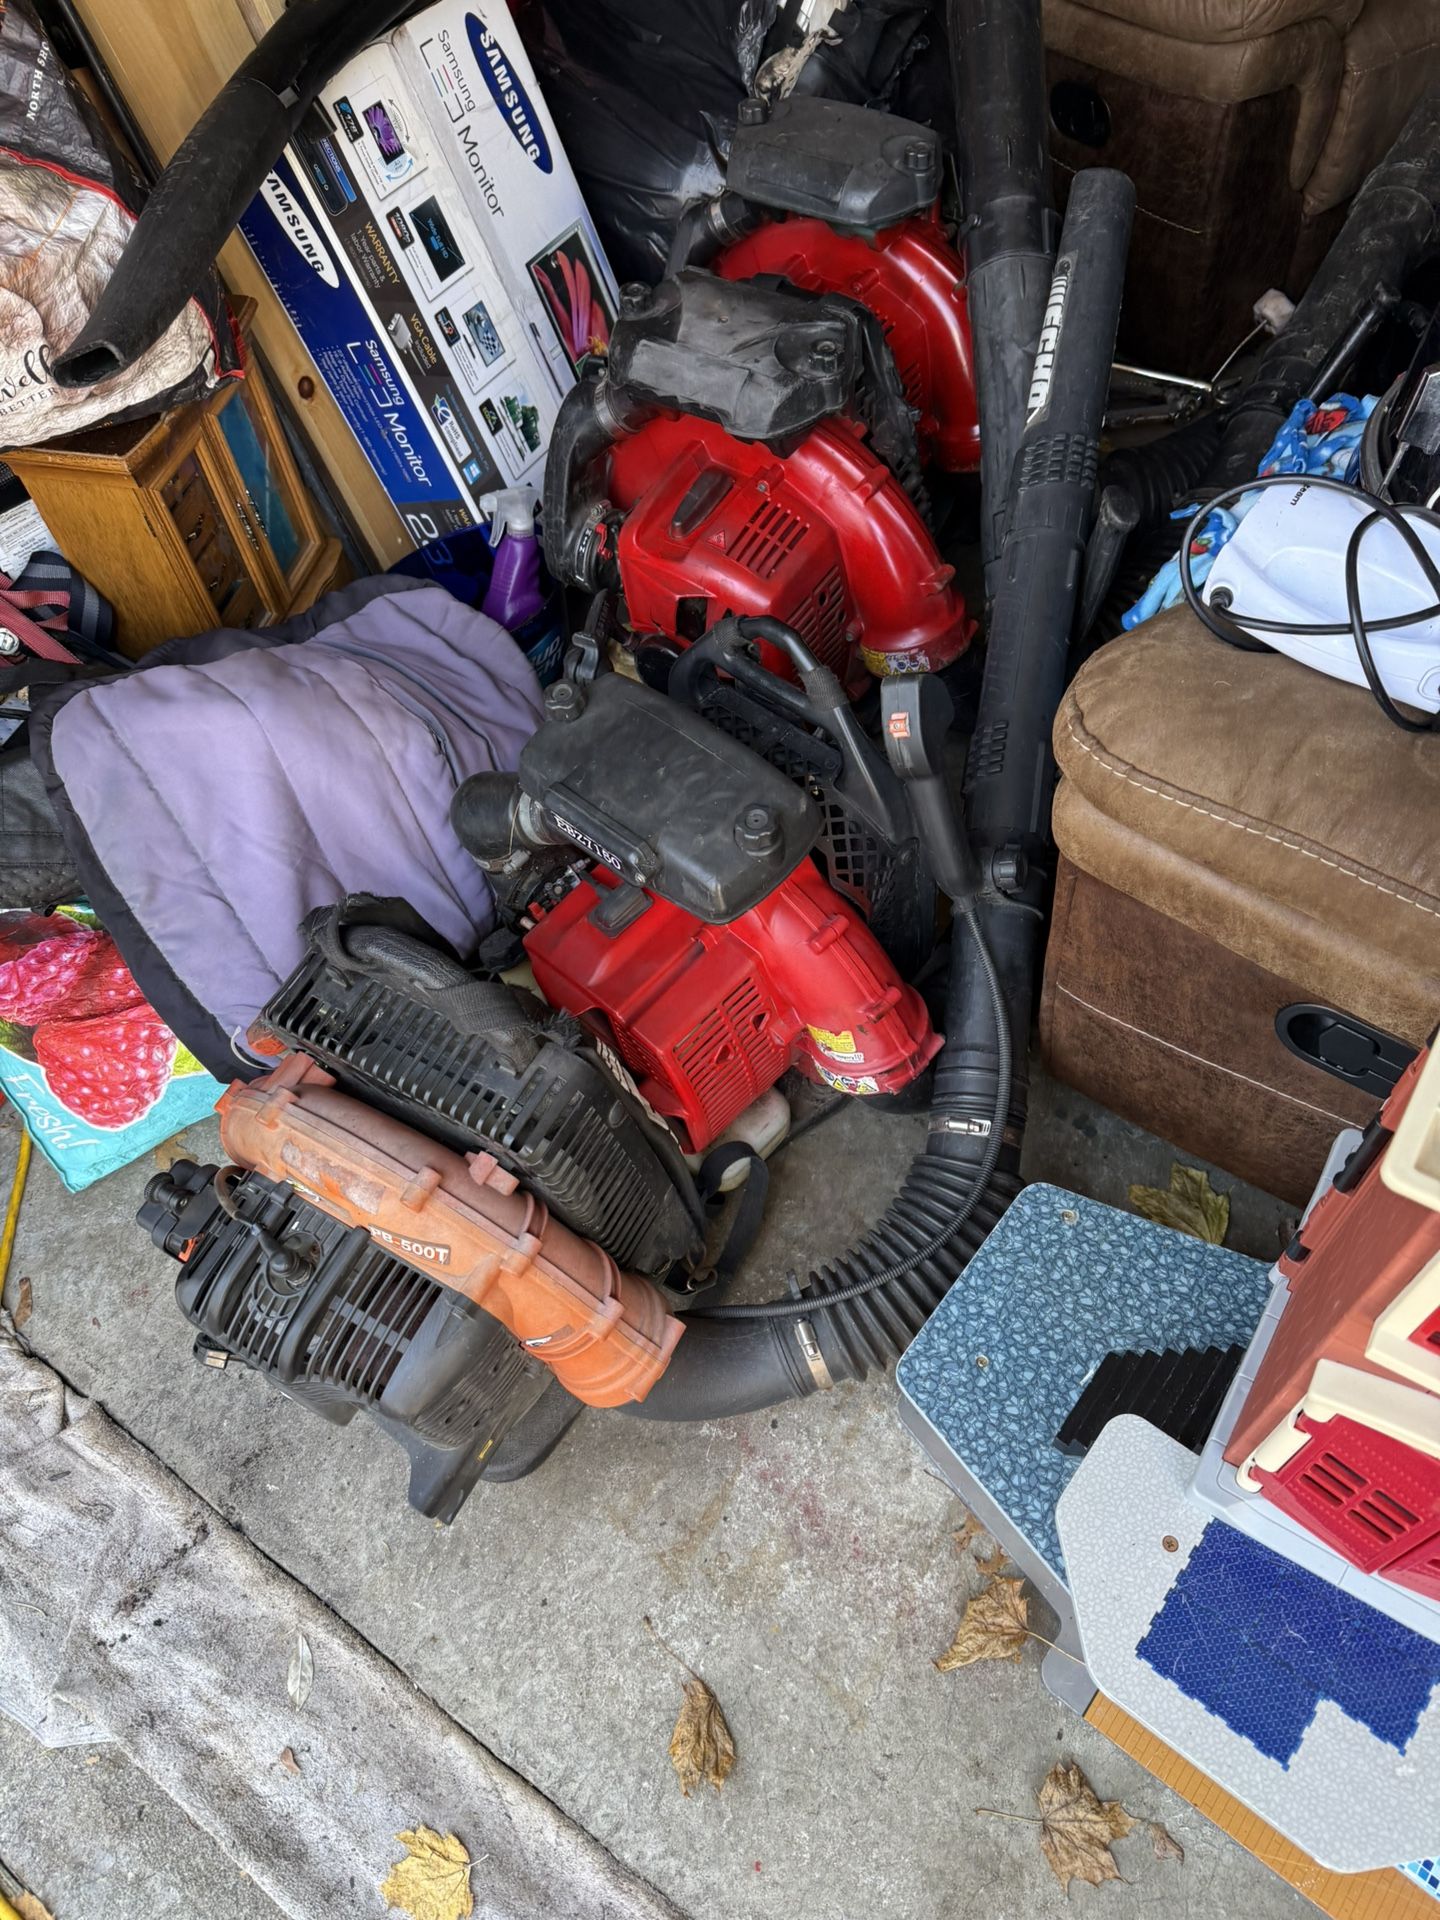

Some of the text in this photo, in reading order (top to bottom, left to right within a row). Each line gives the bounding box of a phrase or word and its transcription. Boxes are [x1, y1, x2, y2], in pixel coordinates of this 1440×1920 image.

[25, 41, 51, 122] NORTH SHO
[438, 29, 476, 114] Samsung
[480, 29, 541, 163] SAMSUNG
[457, 124, 505, 218] Monitor
[266, 169, 325, 273] AMSUNG
[364, 220, 401, 285] WARRANTY
[351, 232, 381, 289] labor Warranty
[360, 234, 373, 252] Year
[369, 252, 382, 277] parts
[365, 339, 405, 406] Samsung
[410, 313, 437, 365] VGA Cable
[1028, 303, 1064, 409] ECHO
[0, 386, 59, 416] BETTER
[383, 412, 433, 487] Monitor
[458, 508, 472, 527] WAR
[1290, 484, 1312, 506] team
[4, 1073, 101, 1150] Fresh!
[369, 1226, 449, 1264] PB-500T
